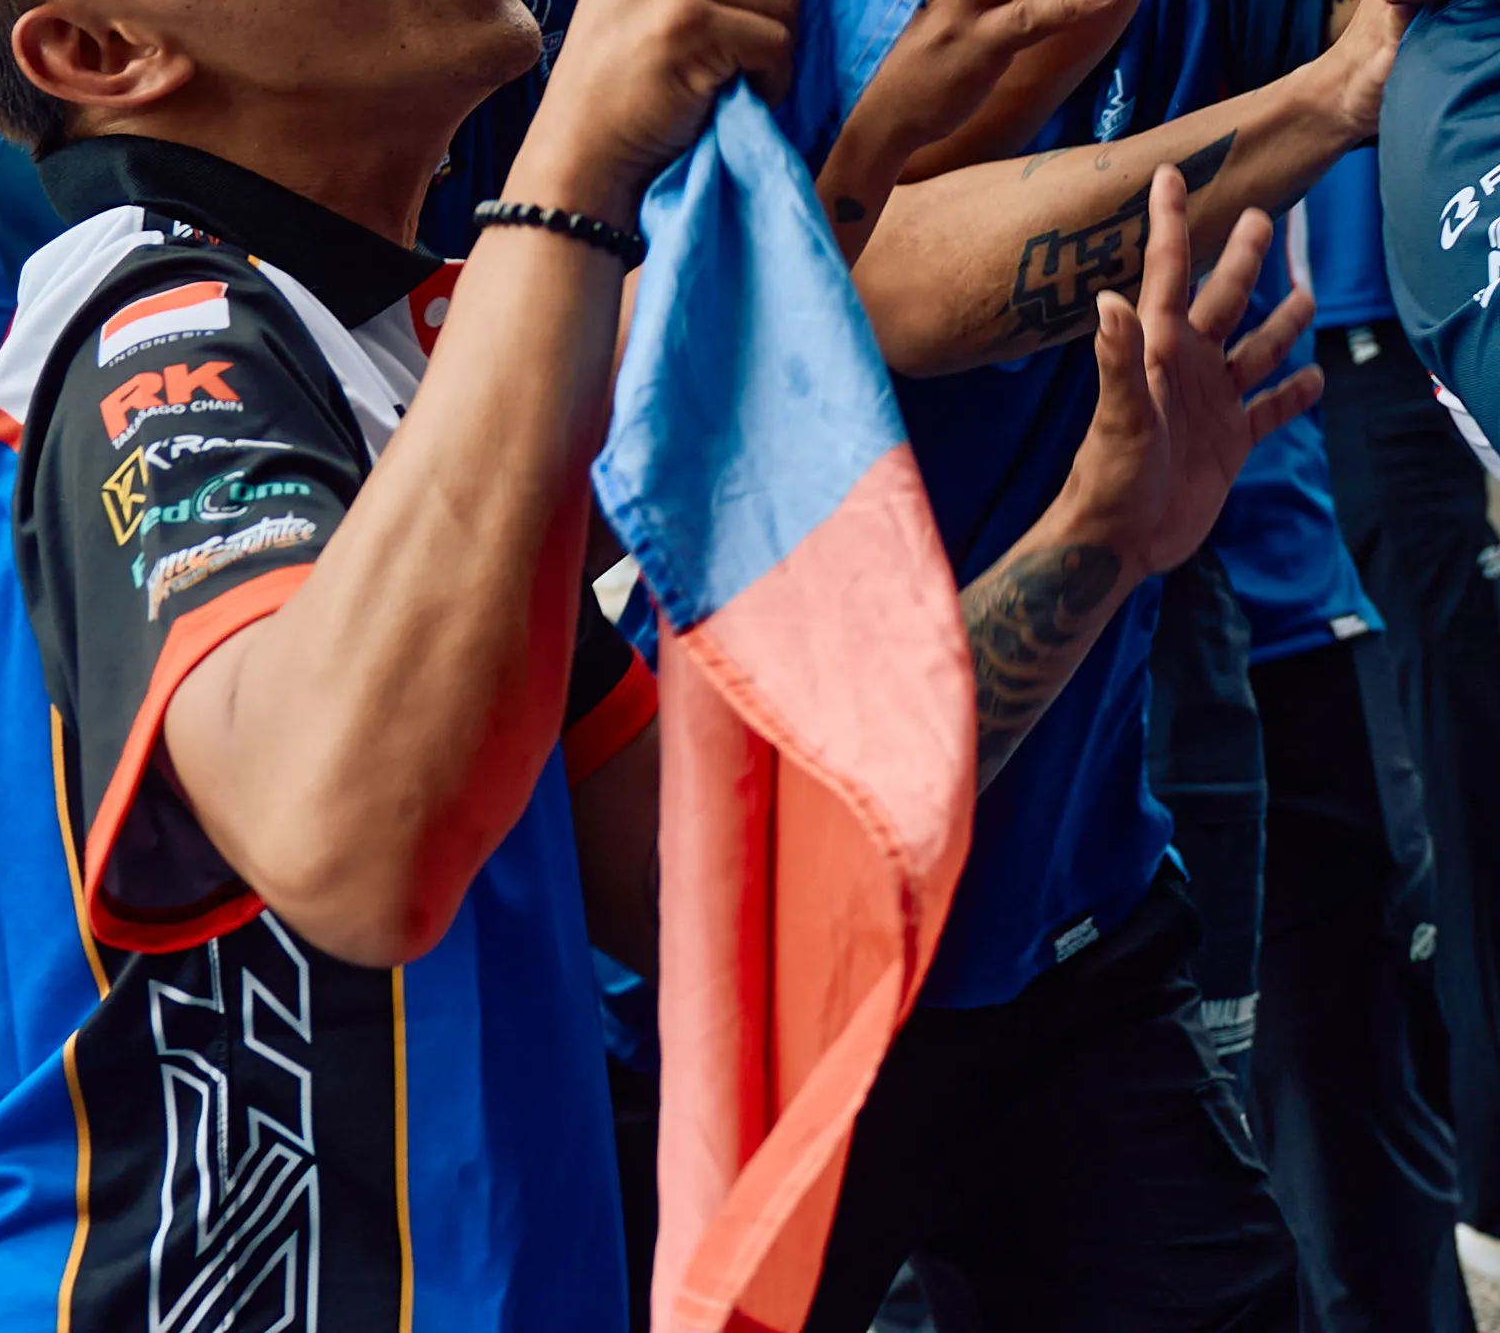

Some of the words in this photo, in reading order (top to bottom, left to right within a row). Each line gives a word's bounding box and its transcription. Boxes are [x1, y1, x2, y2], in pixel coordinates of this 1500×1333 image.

[108, 329, 216, 368] INDONESIA
[99, 360, 242, 443] RK
[190, 399, 244, 413] CHAIN
